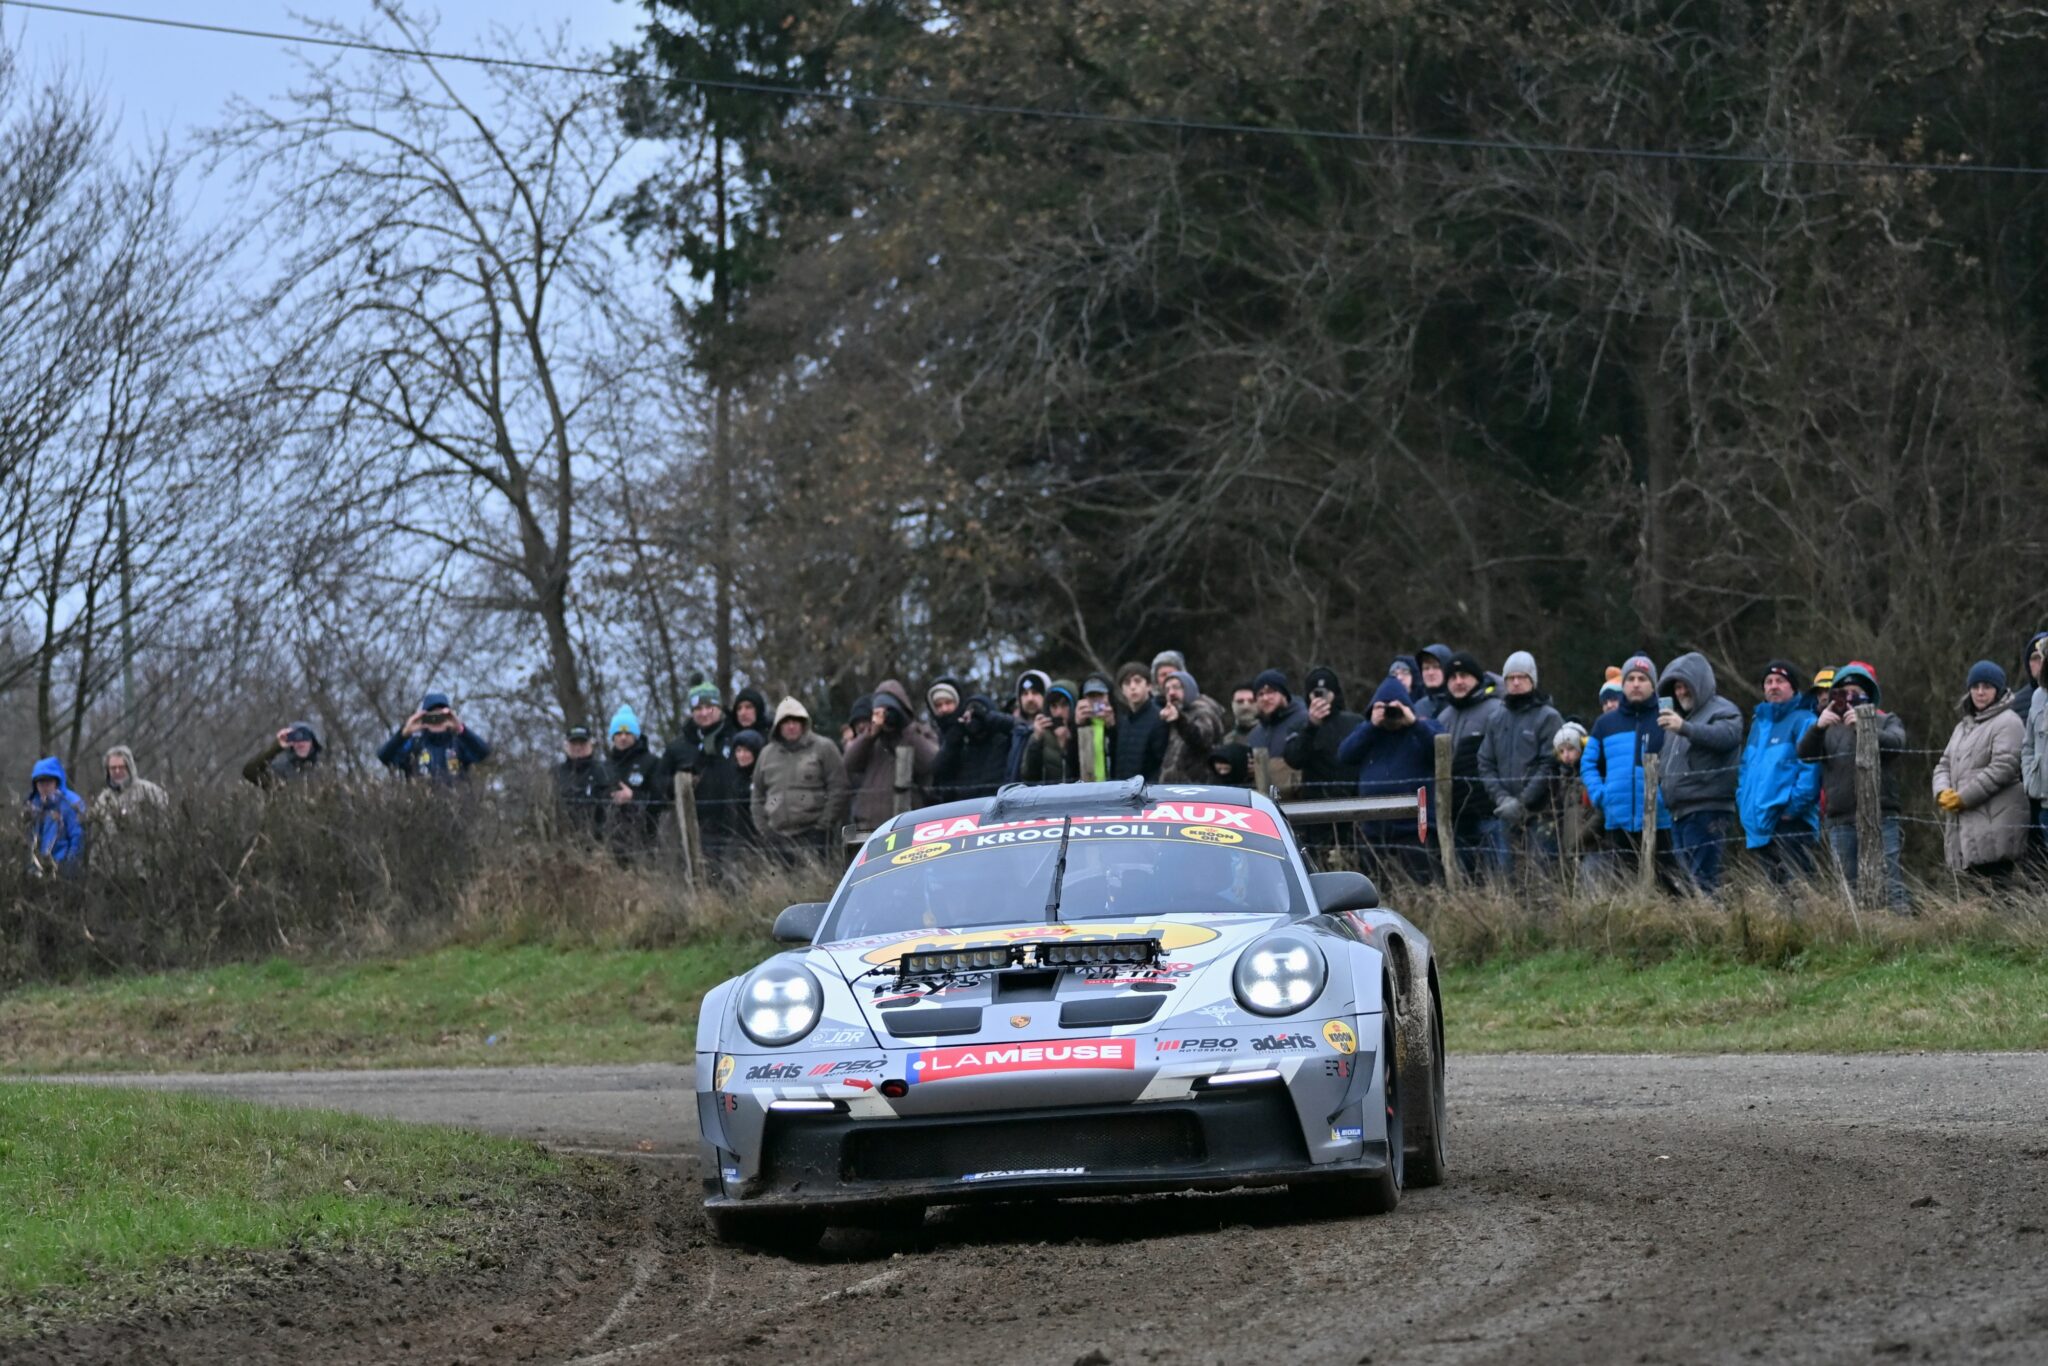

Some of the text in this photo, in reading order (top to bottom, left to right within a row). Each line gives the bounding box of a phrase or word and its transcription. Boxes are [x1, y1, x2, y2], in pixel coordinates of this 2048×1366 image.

[976, 824, 1154, 847] KROON-OIL
[1189, 830, 1234, 839] KROON
[885, 833, 896, 851] 1
[900, 846, 942, 860] KROON
[911, 852, 928, 860] OIL
[824, 1031, 865, 1043] JDR
[1250, 1033, 1317, 1051] adéris
[1328, 1032, 1352, 1042] KROON
[1181, 1038, 1239, 1049] PBO
[745, 1062, 804, 1080] adéris
[829, 1060, 888, 1073] PBO
[823, 1069, 879, 1077] MOTORSPORT
